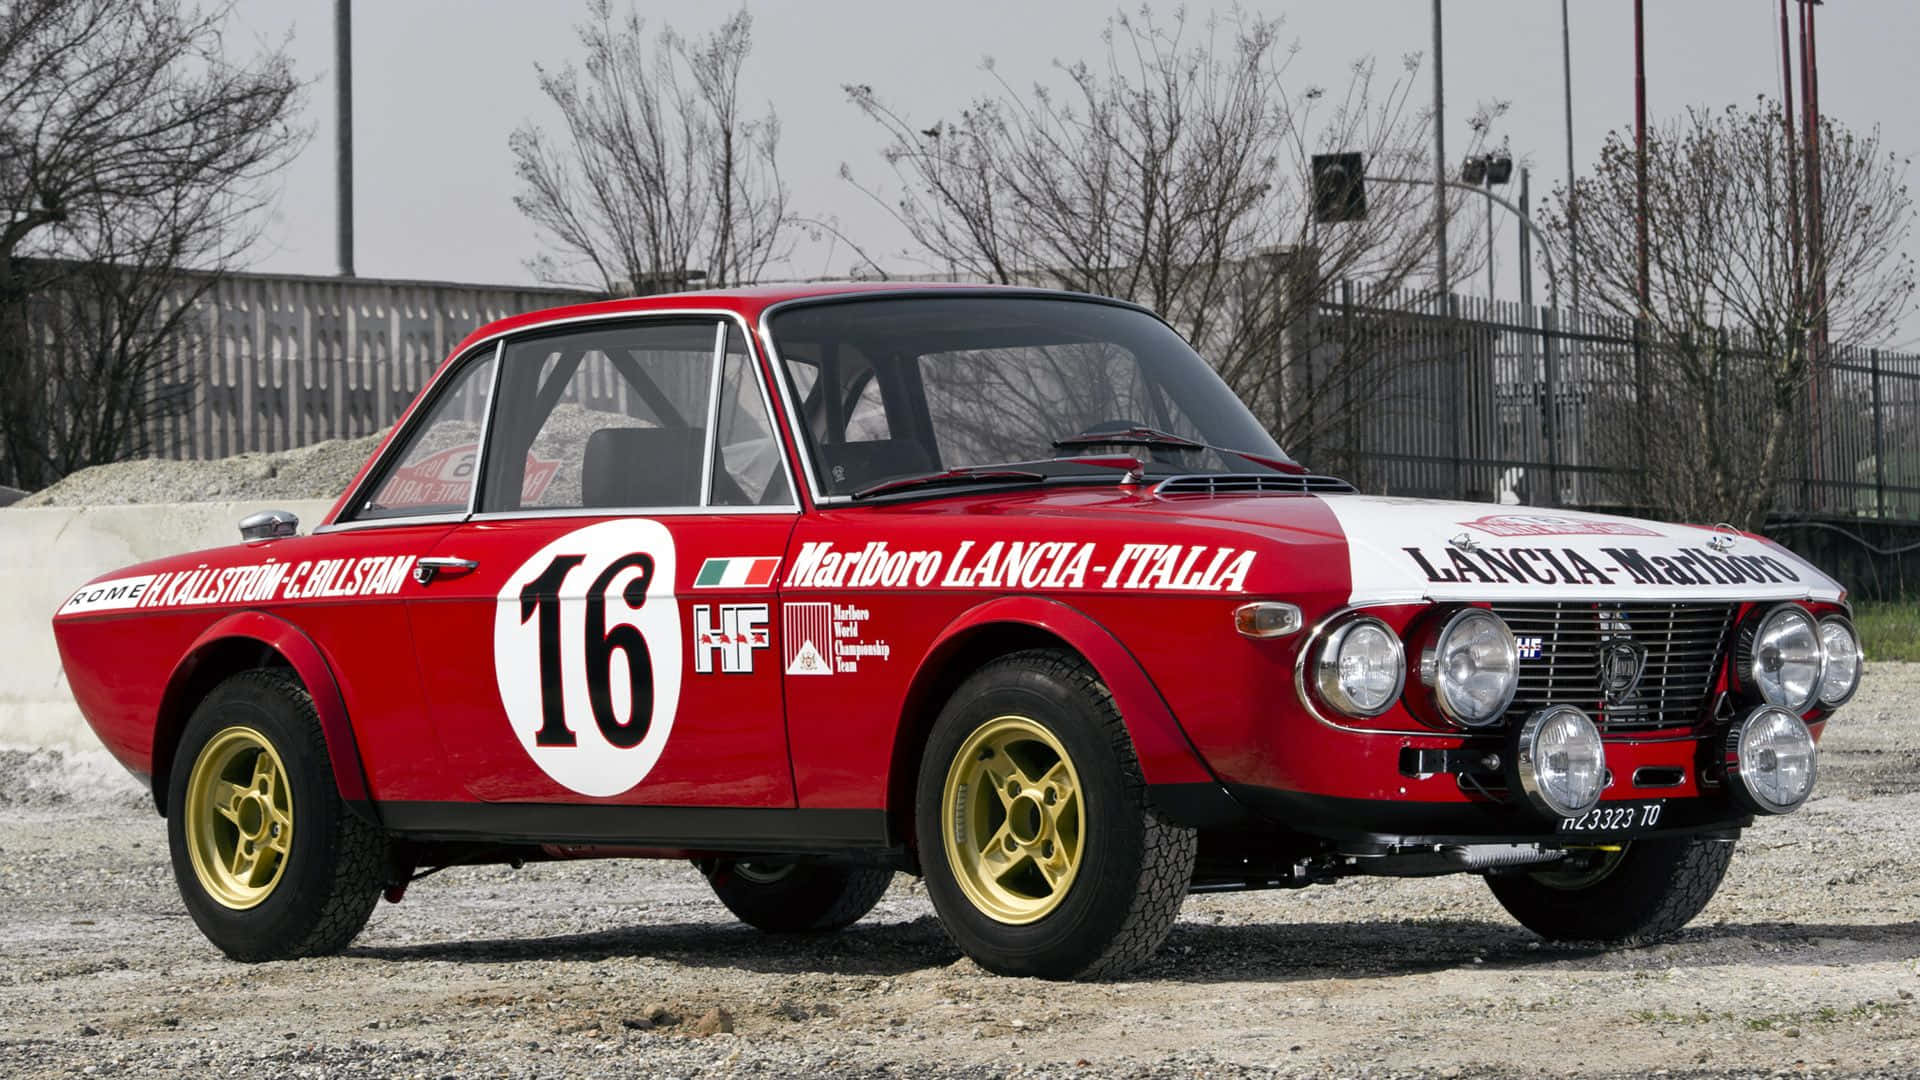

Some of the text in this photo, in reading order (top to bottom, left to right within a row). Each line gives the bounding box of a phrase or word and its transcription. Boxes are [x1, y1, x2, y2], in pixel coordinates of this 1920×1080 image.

[783, 541, 942, 588] Marlboro
[1402, 546, 1801, 586] LANCIA-Marlboro
[69, 583, 147, 606] ROME
[833, 604, 870, 621] Marlboro
[693, 603, 770, 675] HF
[833, 621, 859, 637] World
[519, 551, 656, 750] 16
[835, 639, 890, 662] Championship
[1516, 637, 1542, 658] HF
[835, 656, 858, 673] Team
[1640, 804, 1661, 827] TO
